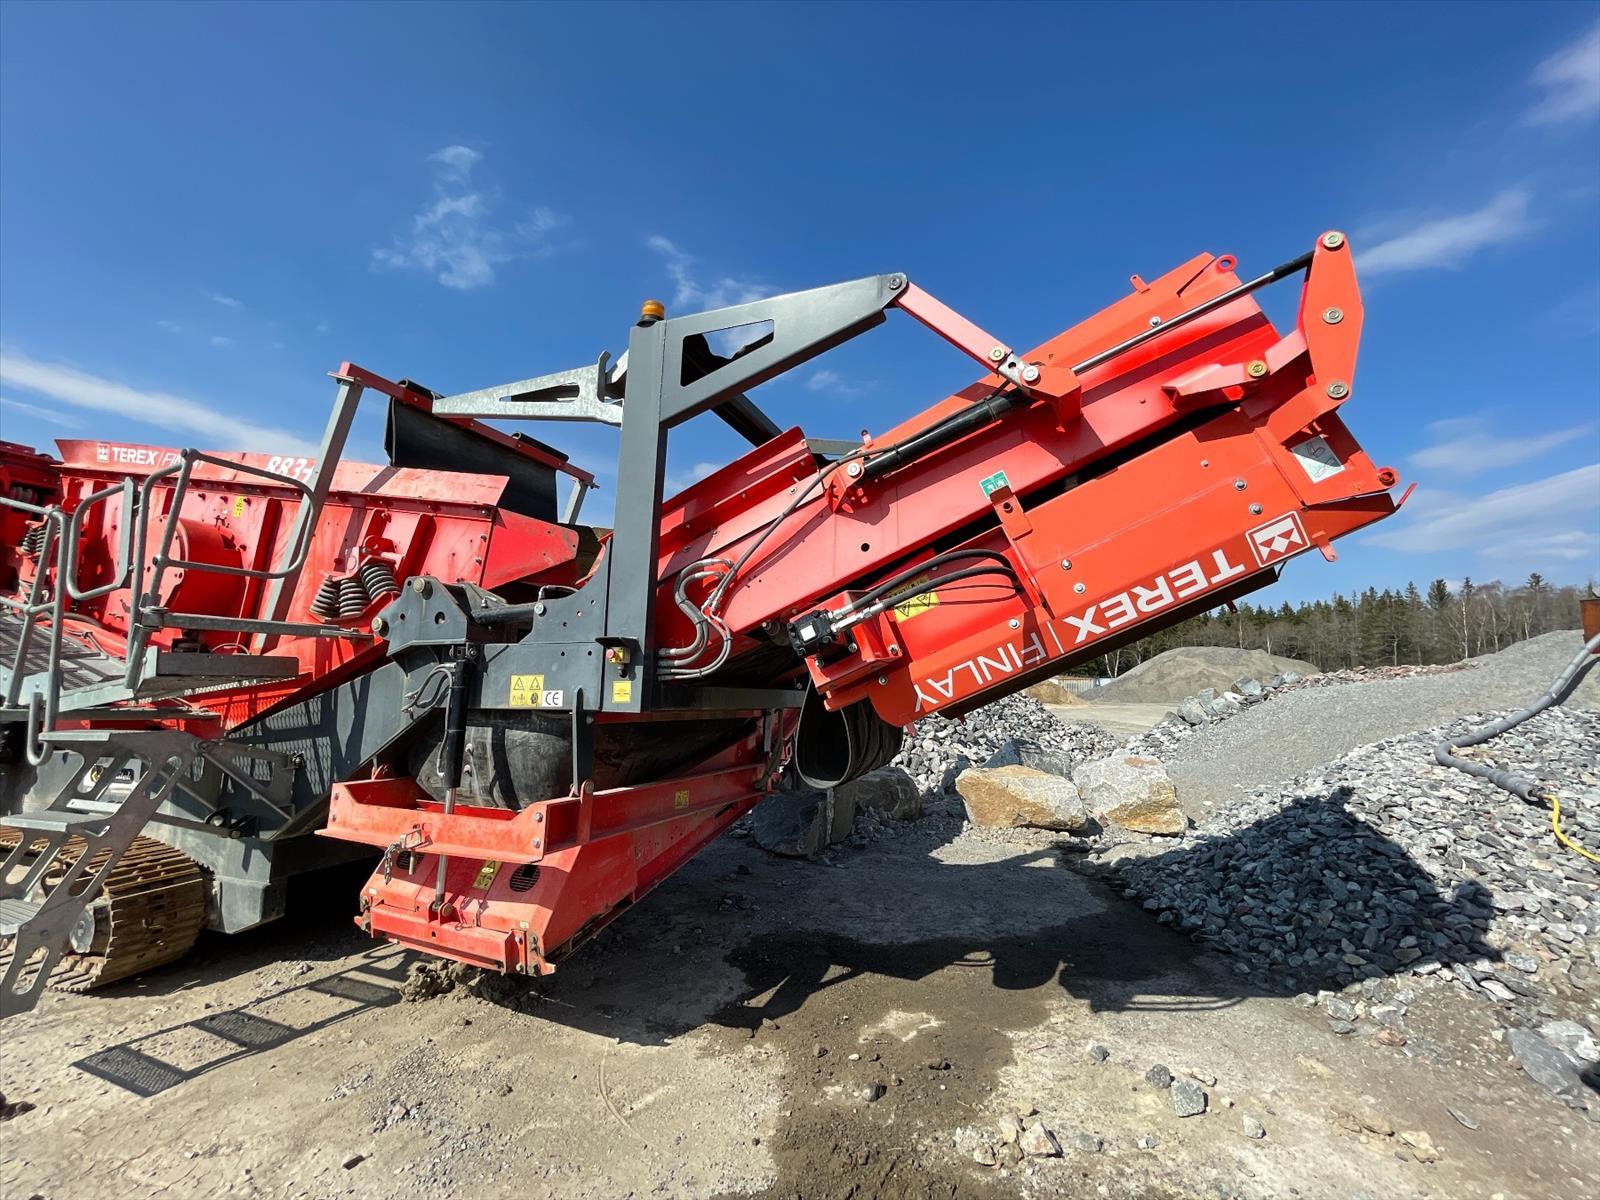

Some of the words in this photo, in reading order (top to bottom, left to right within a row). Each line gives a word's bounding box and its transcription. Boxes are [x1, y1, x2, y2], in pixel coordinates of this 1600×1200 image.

[111, 446, 159, 465] TEREX
[1062, 549, 1246, 644] TEREX
[913, 631, 1047, 713] FINLAY
[545, 691, 559, 706] CE
